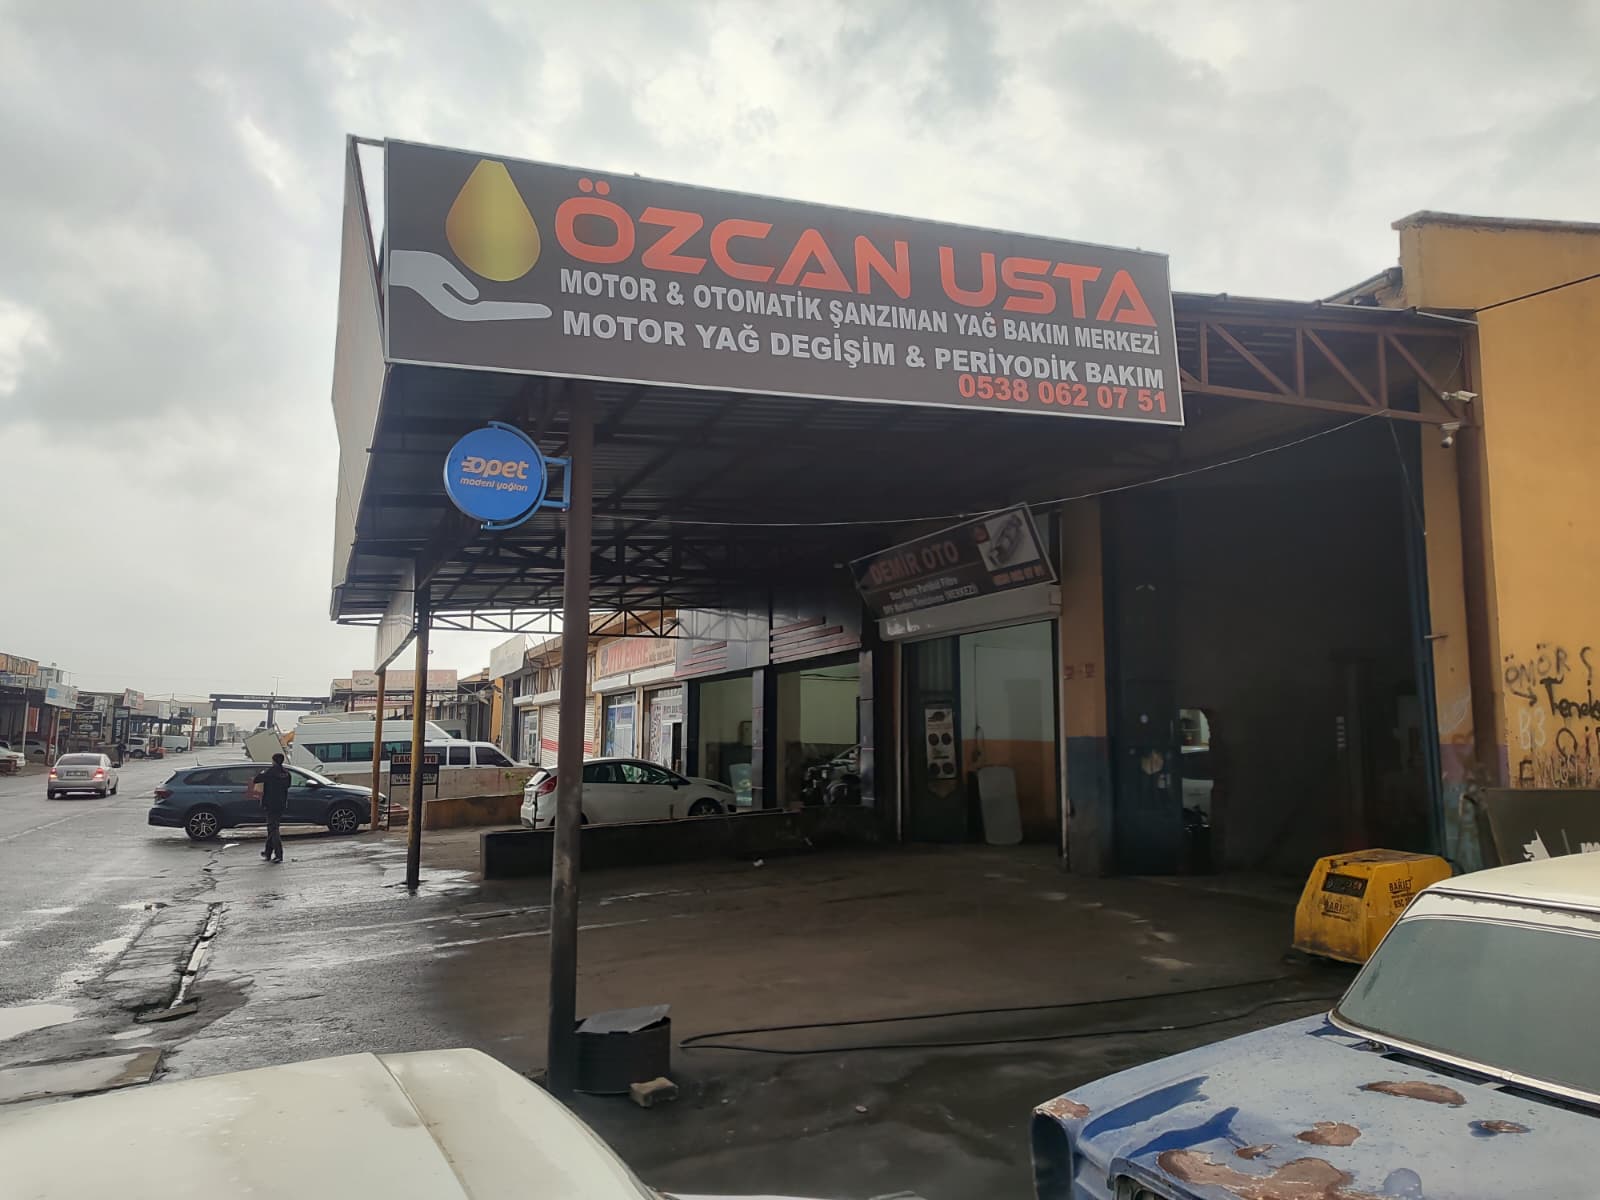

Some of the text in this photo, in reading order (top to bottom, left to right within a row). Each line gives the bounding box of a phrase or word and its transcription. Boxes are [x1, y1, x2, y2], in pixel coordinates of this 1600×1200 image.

[555, 178, 1157, 327] ÖZCAN USTA
[560, 268, 1160, 355] MOTOR & OTOMATİK ŞANZIMAN YAĞ BAKIM MERKEZİ
[563, 309, 1164, 390] MOTOR YAĞ DEGİŞİM & PERİYODİK BAKIM
[958, 374, 1167, 413] 0538 062 07 51
[922, 540, 961, 570] OTO
